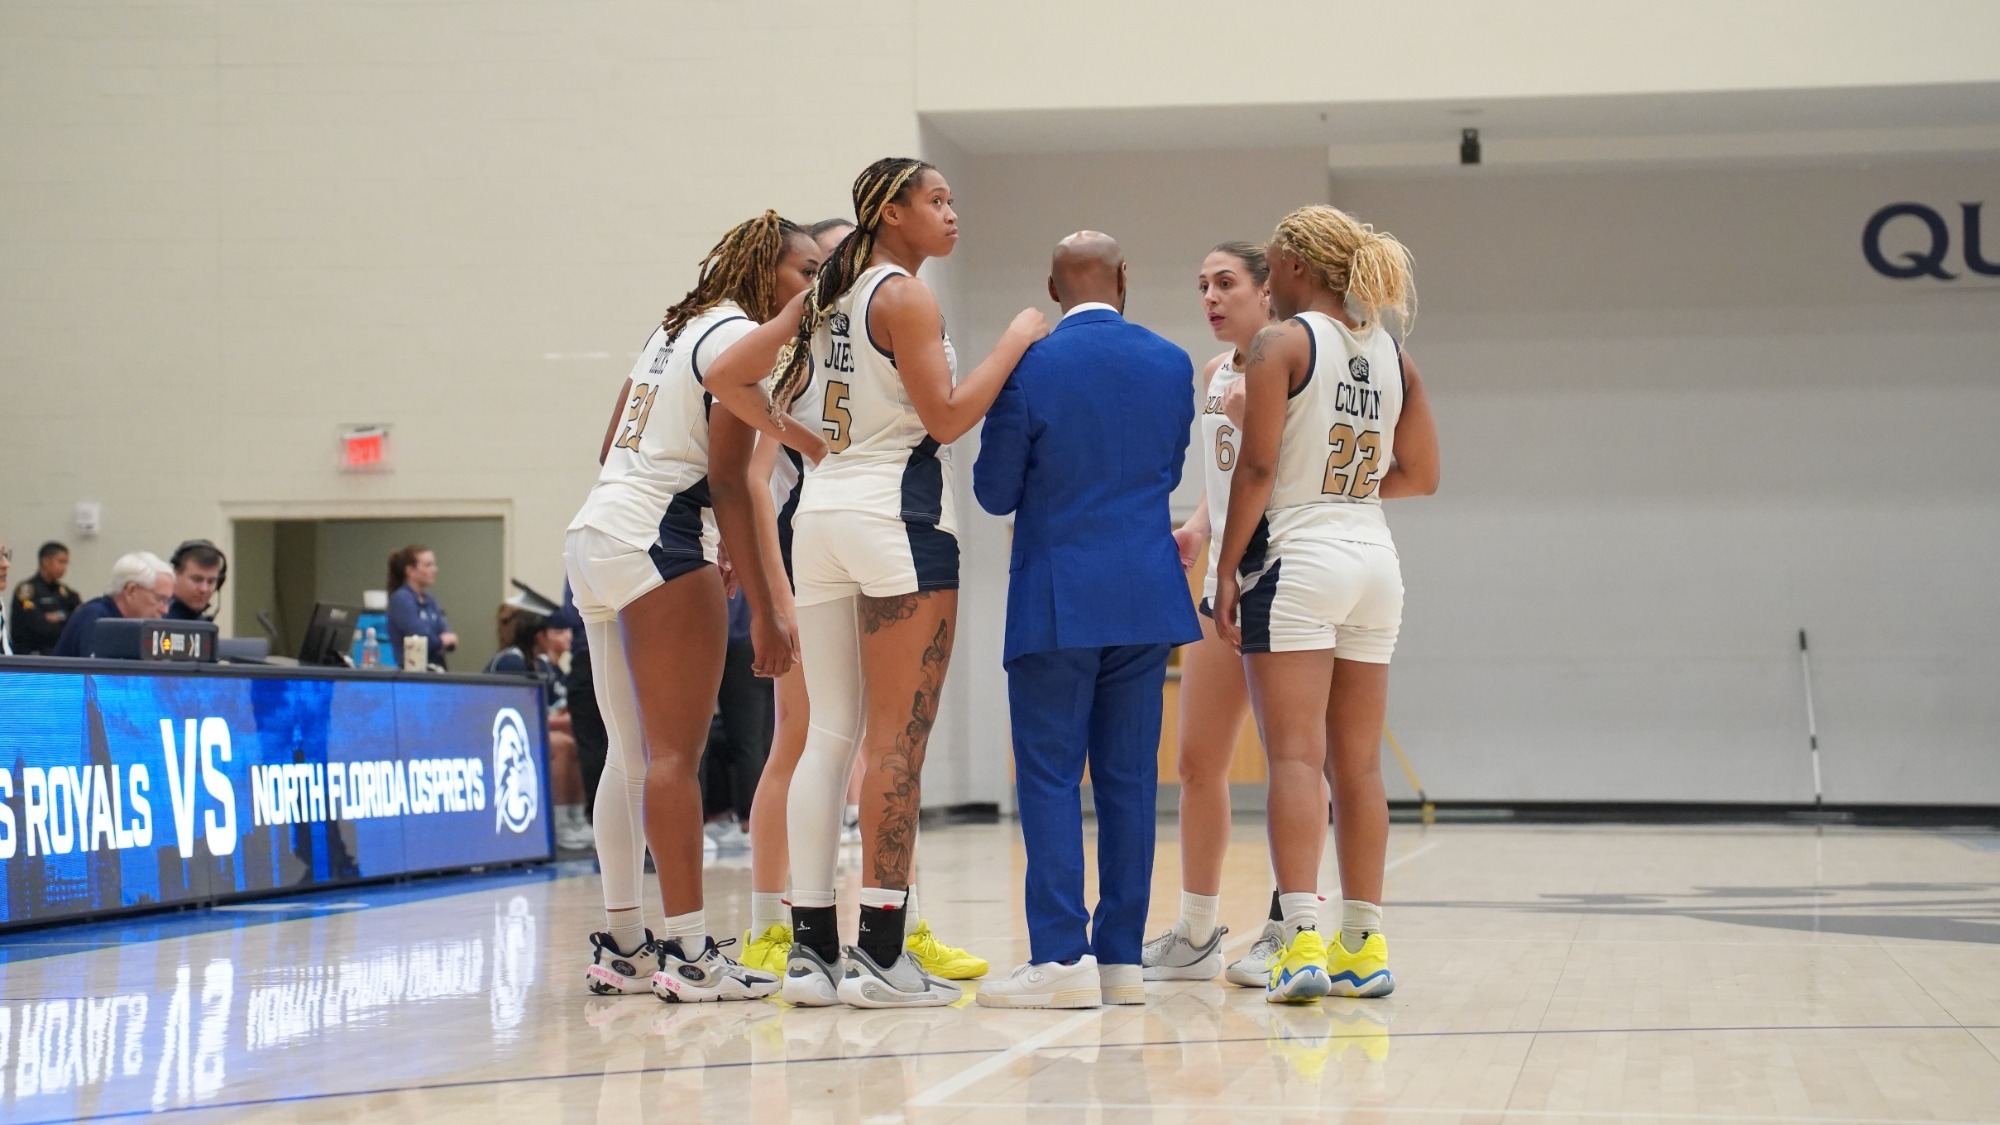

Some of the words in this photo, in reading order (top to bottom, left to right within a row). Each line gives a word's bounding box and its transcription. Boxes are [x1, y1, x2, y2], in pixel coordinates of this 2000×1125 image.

[822, 380, 852, 454] 5
[1215, 424, 1236, 472] 6
[1321, 422, 1381, 499] 22
[23, 763, 153, 857] ROYALS
[160, 717, 237, 858] VS
[251, 762, 327, 826] NORTH
[327, 759, 410, 821] FLORIDA
[408, 757, 486, 815] OSPREYS
